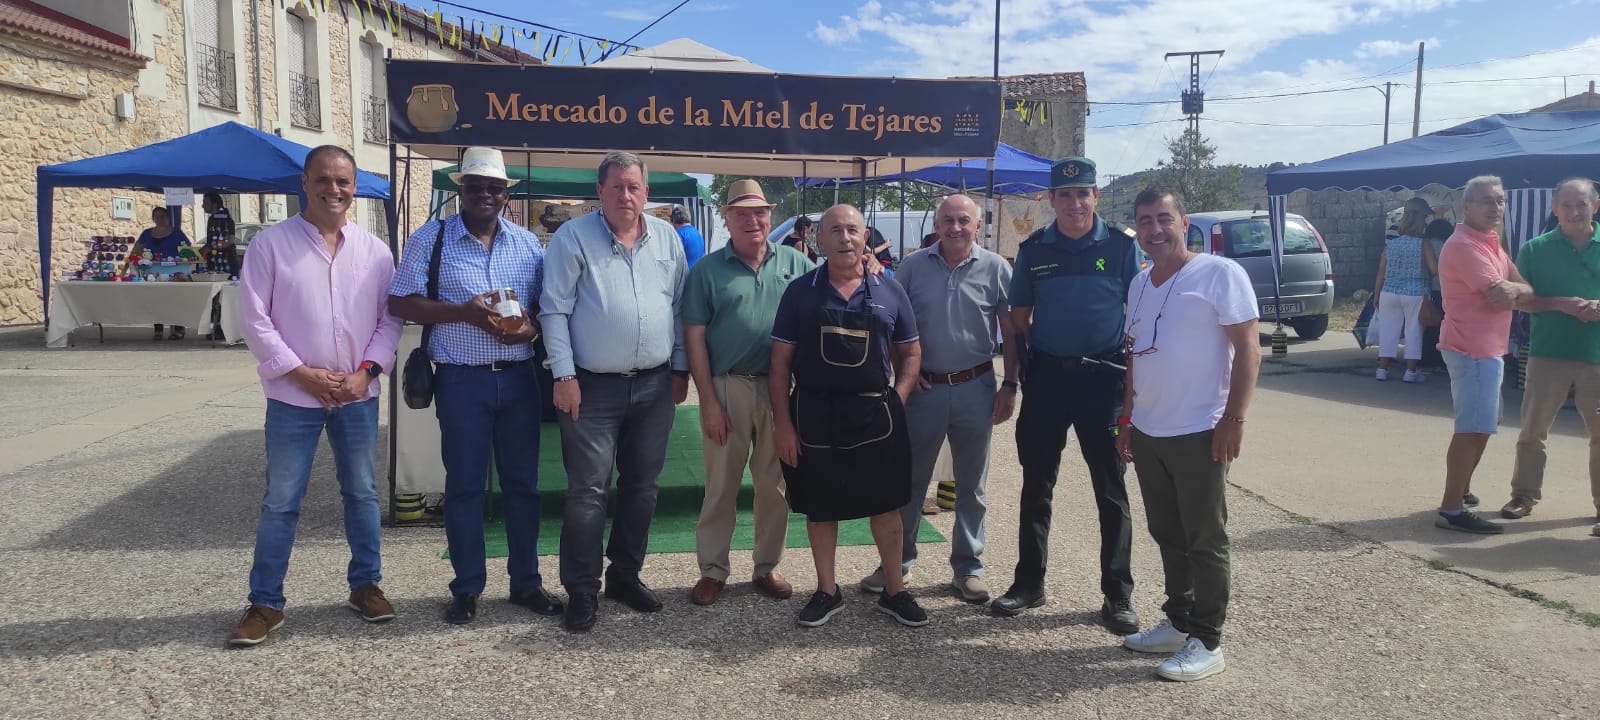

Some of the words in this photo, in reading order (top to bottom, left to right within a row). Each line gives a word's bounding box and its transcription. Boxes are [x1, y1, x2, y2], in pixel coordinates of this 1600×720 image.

[485, 91, 627, 125] Mercado
[637, 95, 674, 127] de
[684, 96, 712, 128] la
[721, 98, 790, 129] Miel
[799, 101, 834, 131] de
[842, 103, 943, 141] Tejares
